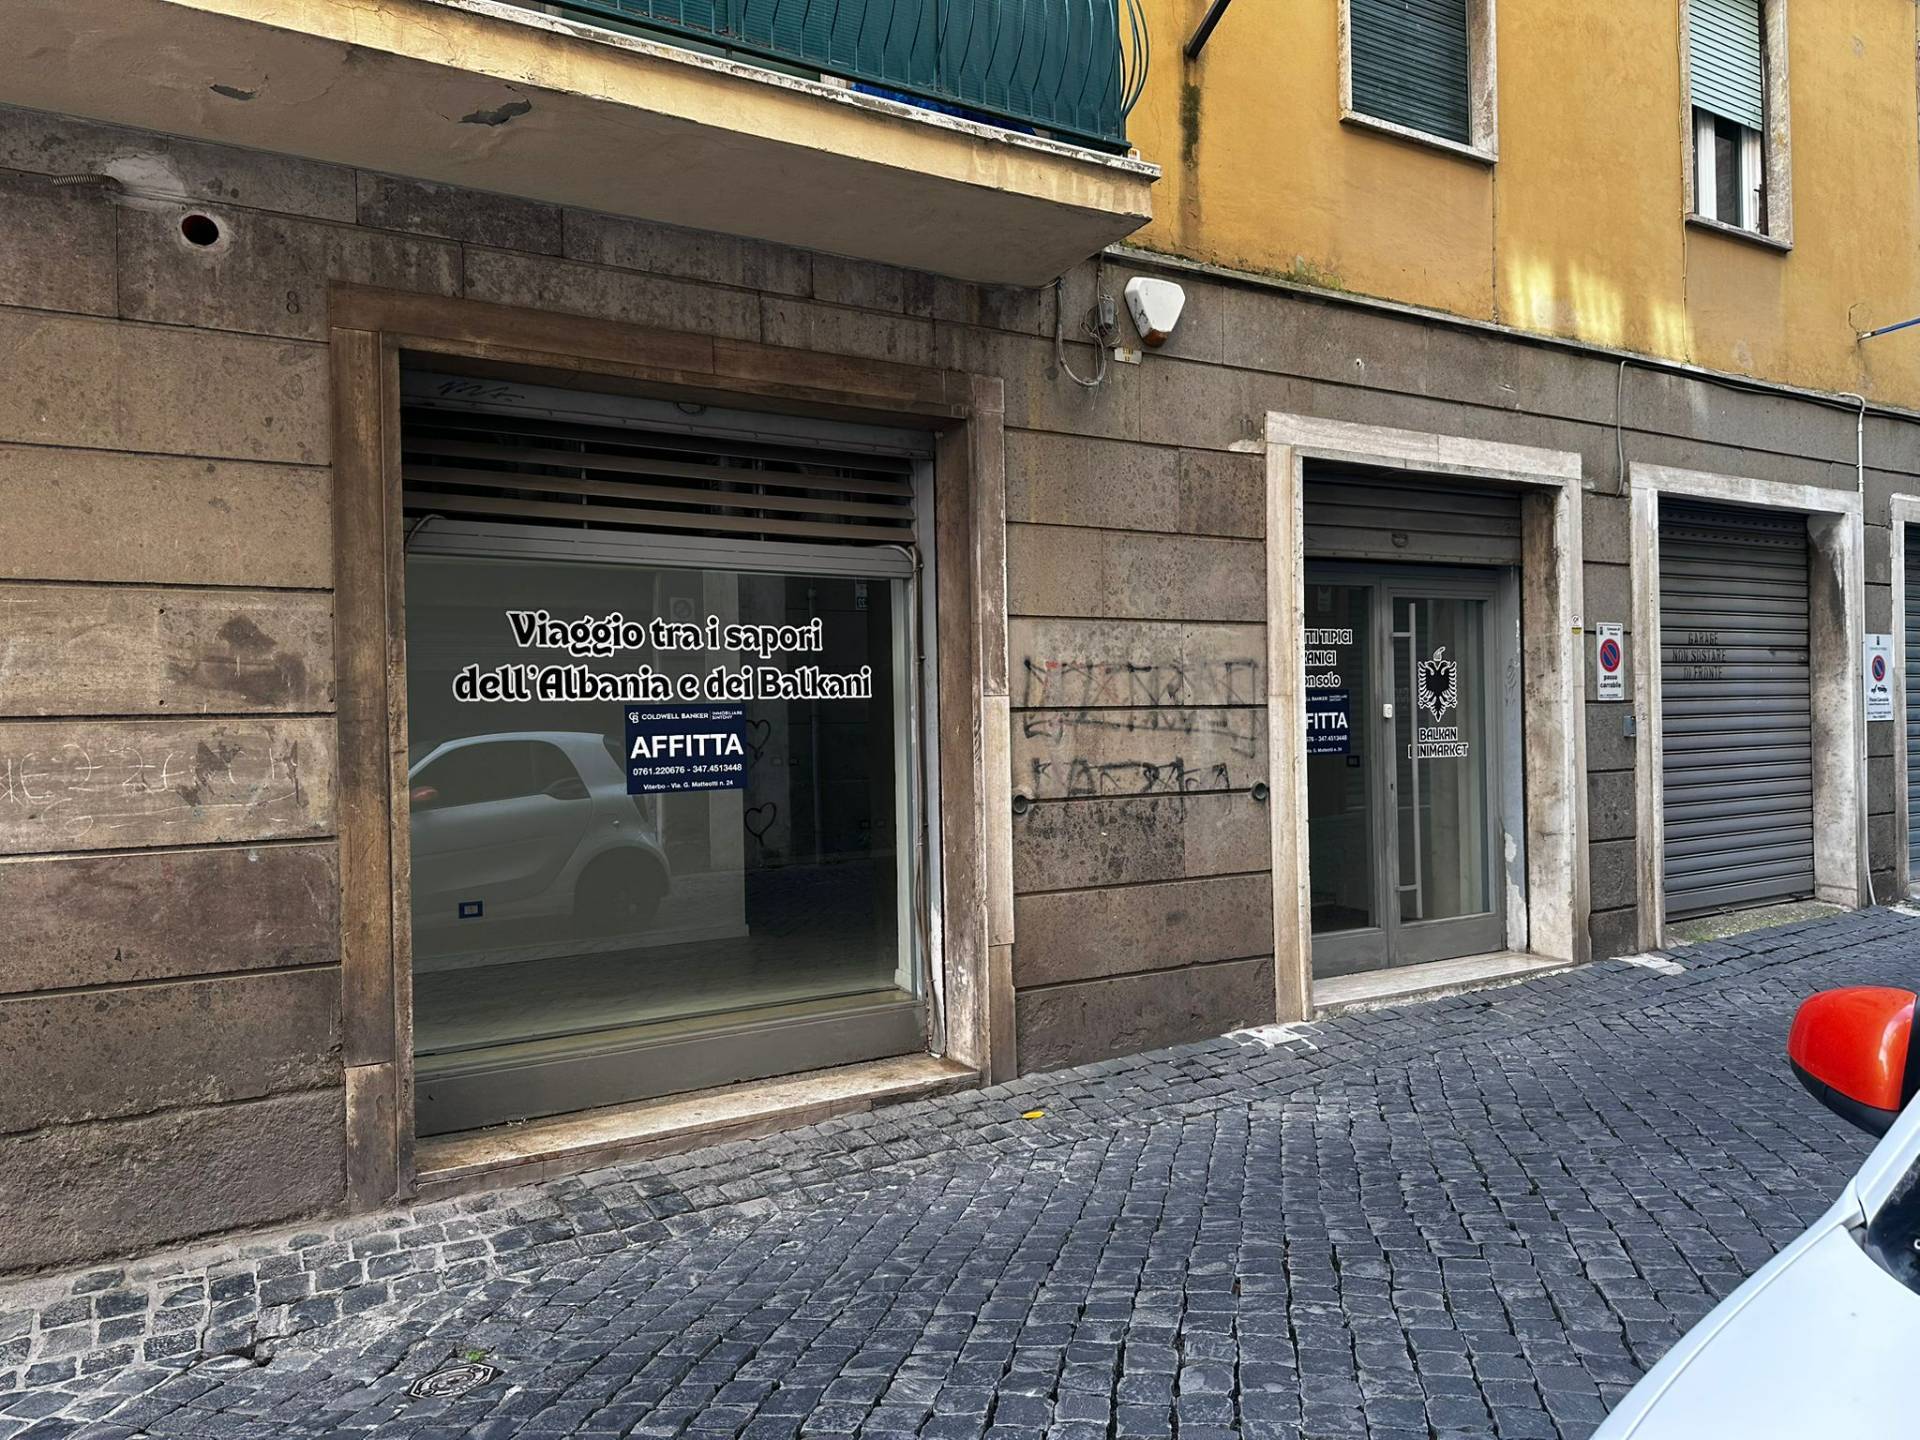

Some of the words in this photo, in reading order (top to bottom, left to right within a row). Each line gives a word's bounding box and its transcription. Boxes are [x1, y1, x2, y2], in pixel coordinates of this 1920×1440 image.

[506, 609, 645, 657] Viaggio
[651, 615, 705, 651] tra
[706, 616, 720, 651] i
[724, 618, 823, 659] sapori
[1304, 629, 1319, 644] TTI
[1319, 629, 1352, 644] TIPICI
[1688, 632, 1719, 645] GARAGE
[1672, 648, 1689, 663] NON
[1690, 648, 1727, 663] SOSTARE
[1304, 675, 1316, 687] on
[1316, 671, 1341, 687] solo
[1693, 665, 1723, 680] FRONTE
[452, 664, 673, 702] dell'Albania
[676, 674, 701, 700] e
[703, 667, 754, 701] dei
[757, 665, 873, 700] Balkani
[1306, 711, 1348, 730] FITTA
[1418, 726, 1458, 742] BALKAN
[630, 733, 744, 759] AFFITTA
[633, 766, 685, 776] 0761.220676
[692, 764, 742, 773] 347.4513448
